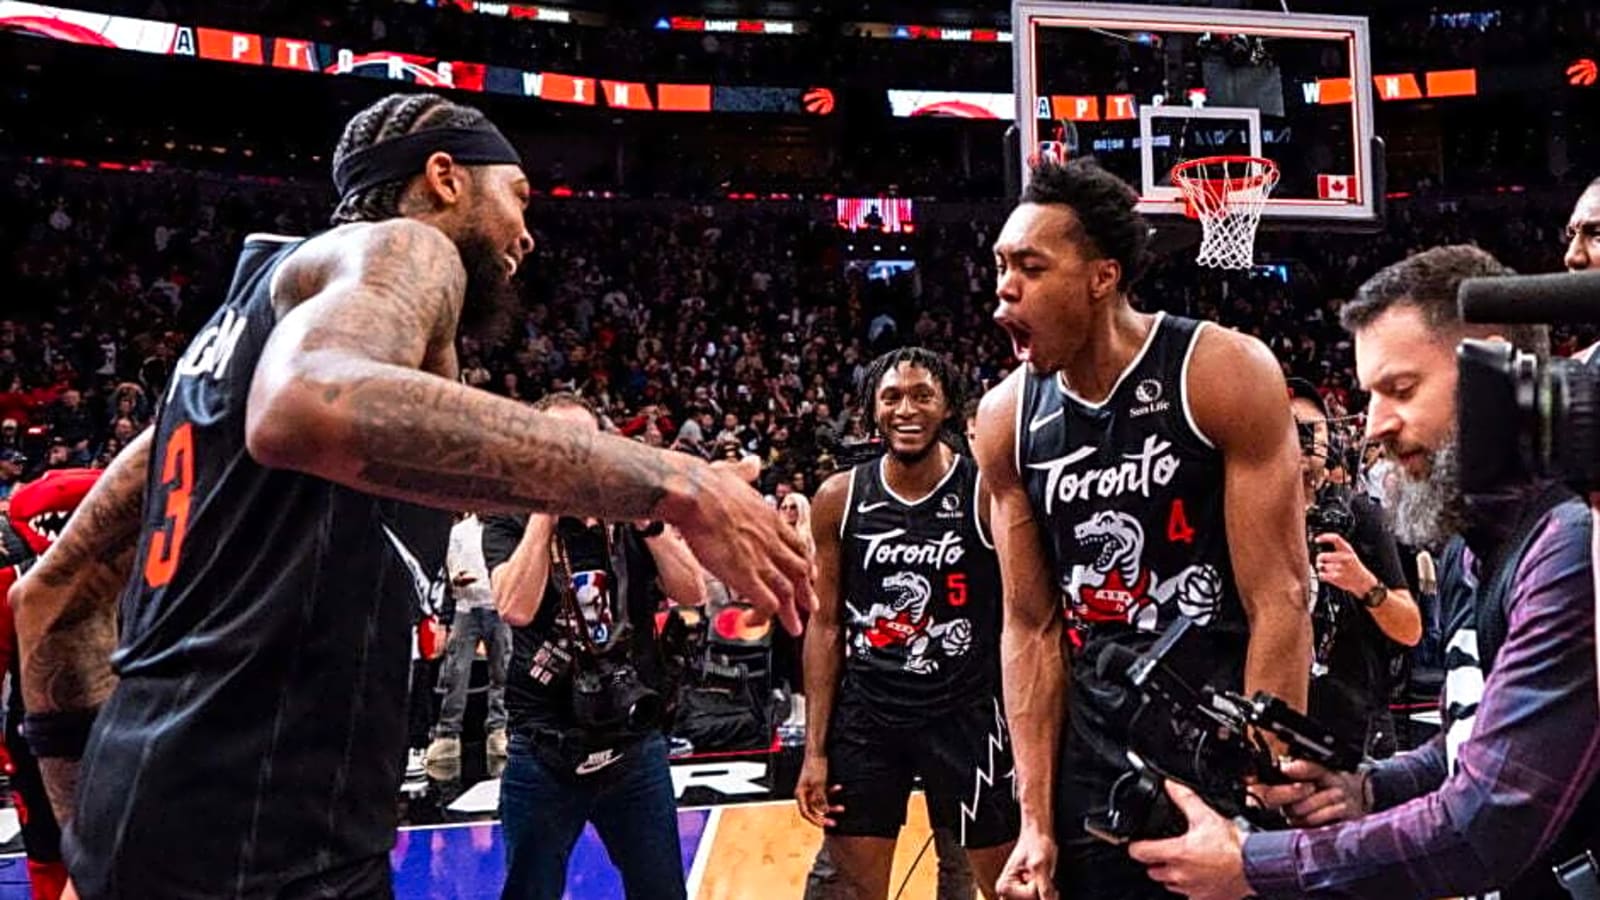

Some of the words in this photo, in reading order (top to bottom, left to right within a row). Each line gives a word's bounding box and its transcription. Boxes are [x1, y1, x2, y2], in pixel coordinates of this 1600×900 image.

[1027, 434, 1181, 515] Toronto
[144, 422, 195, 588] 3
[1167, 498, 1195, 544] 4
[853, 527, 966, 570] Toronto
[945, 573, 969, 607] 5
